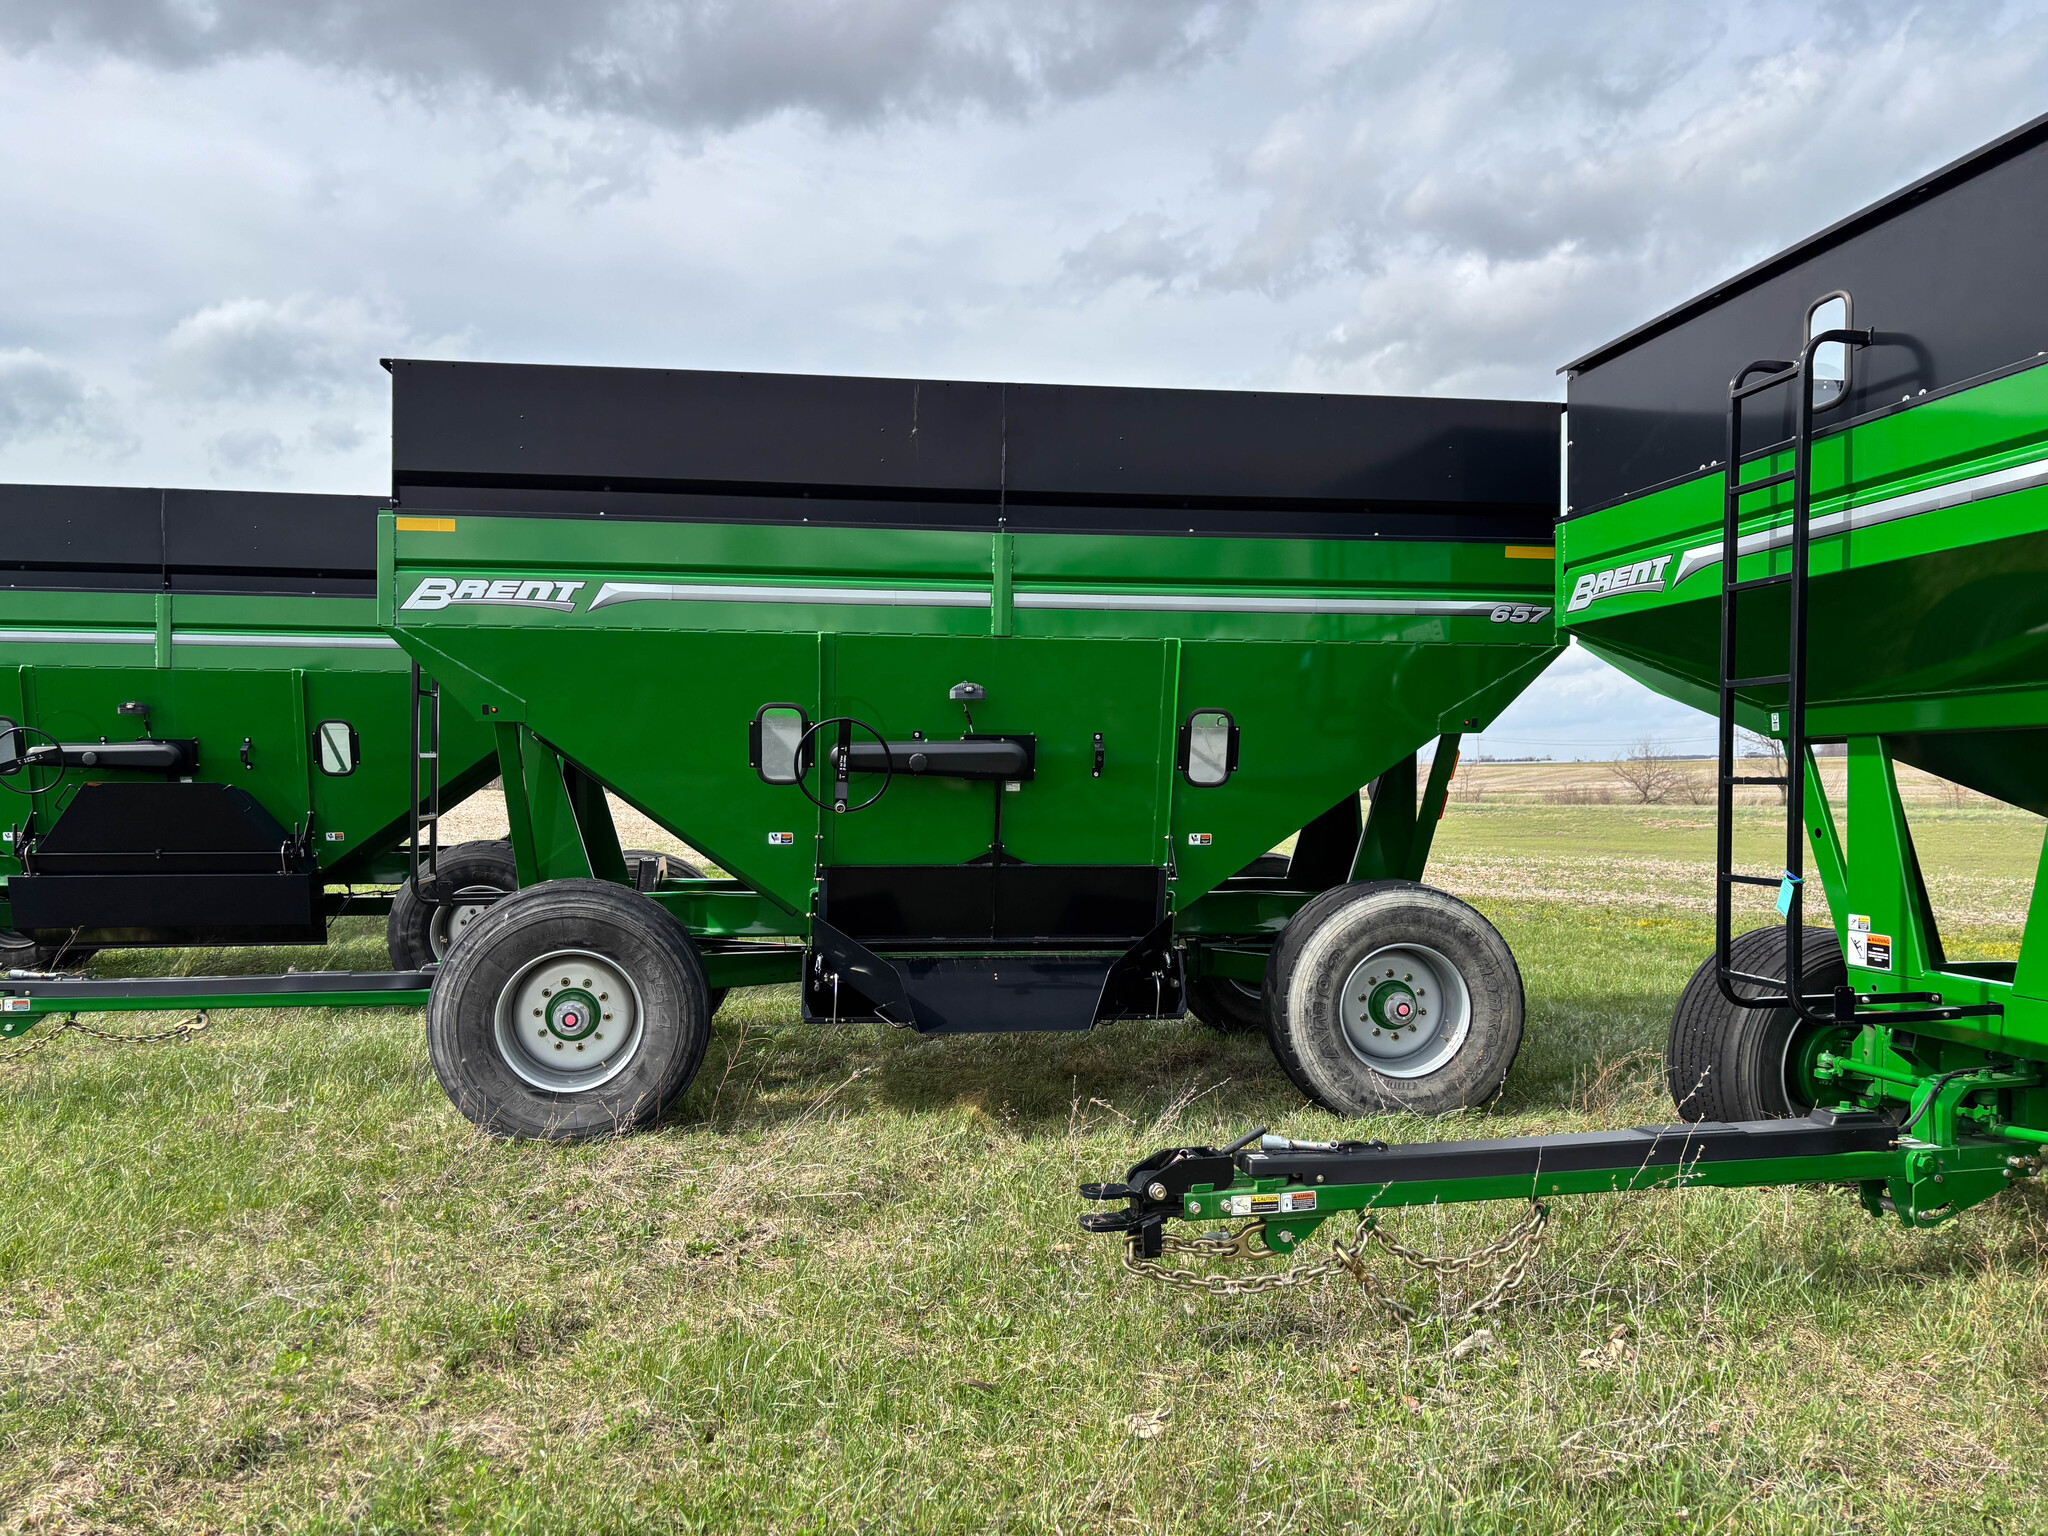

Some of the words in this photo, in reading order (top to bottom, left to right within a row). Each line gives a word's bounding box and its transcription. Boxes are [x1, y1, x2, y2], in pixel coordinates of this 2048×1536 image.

[399, 577, 588, 611] BRENT
[1567, 554, 1673, 612] BRENT
[1490, 605, 1552, 624] 657
[1871, 937, 1890, 945] WARNING
